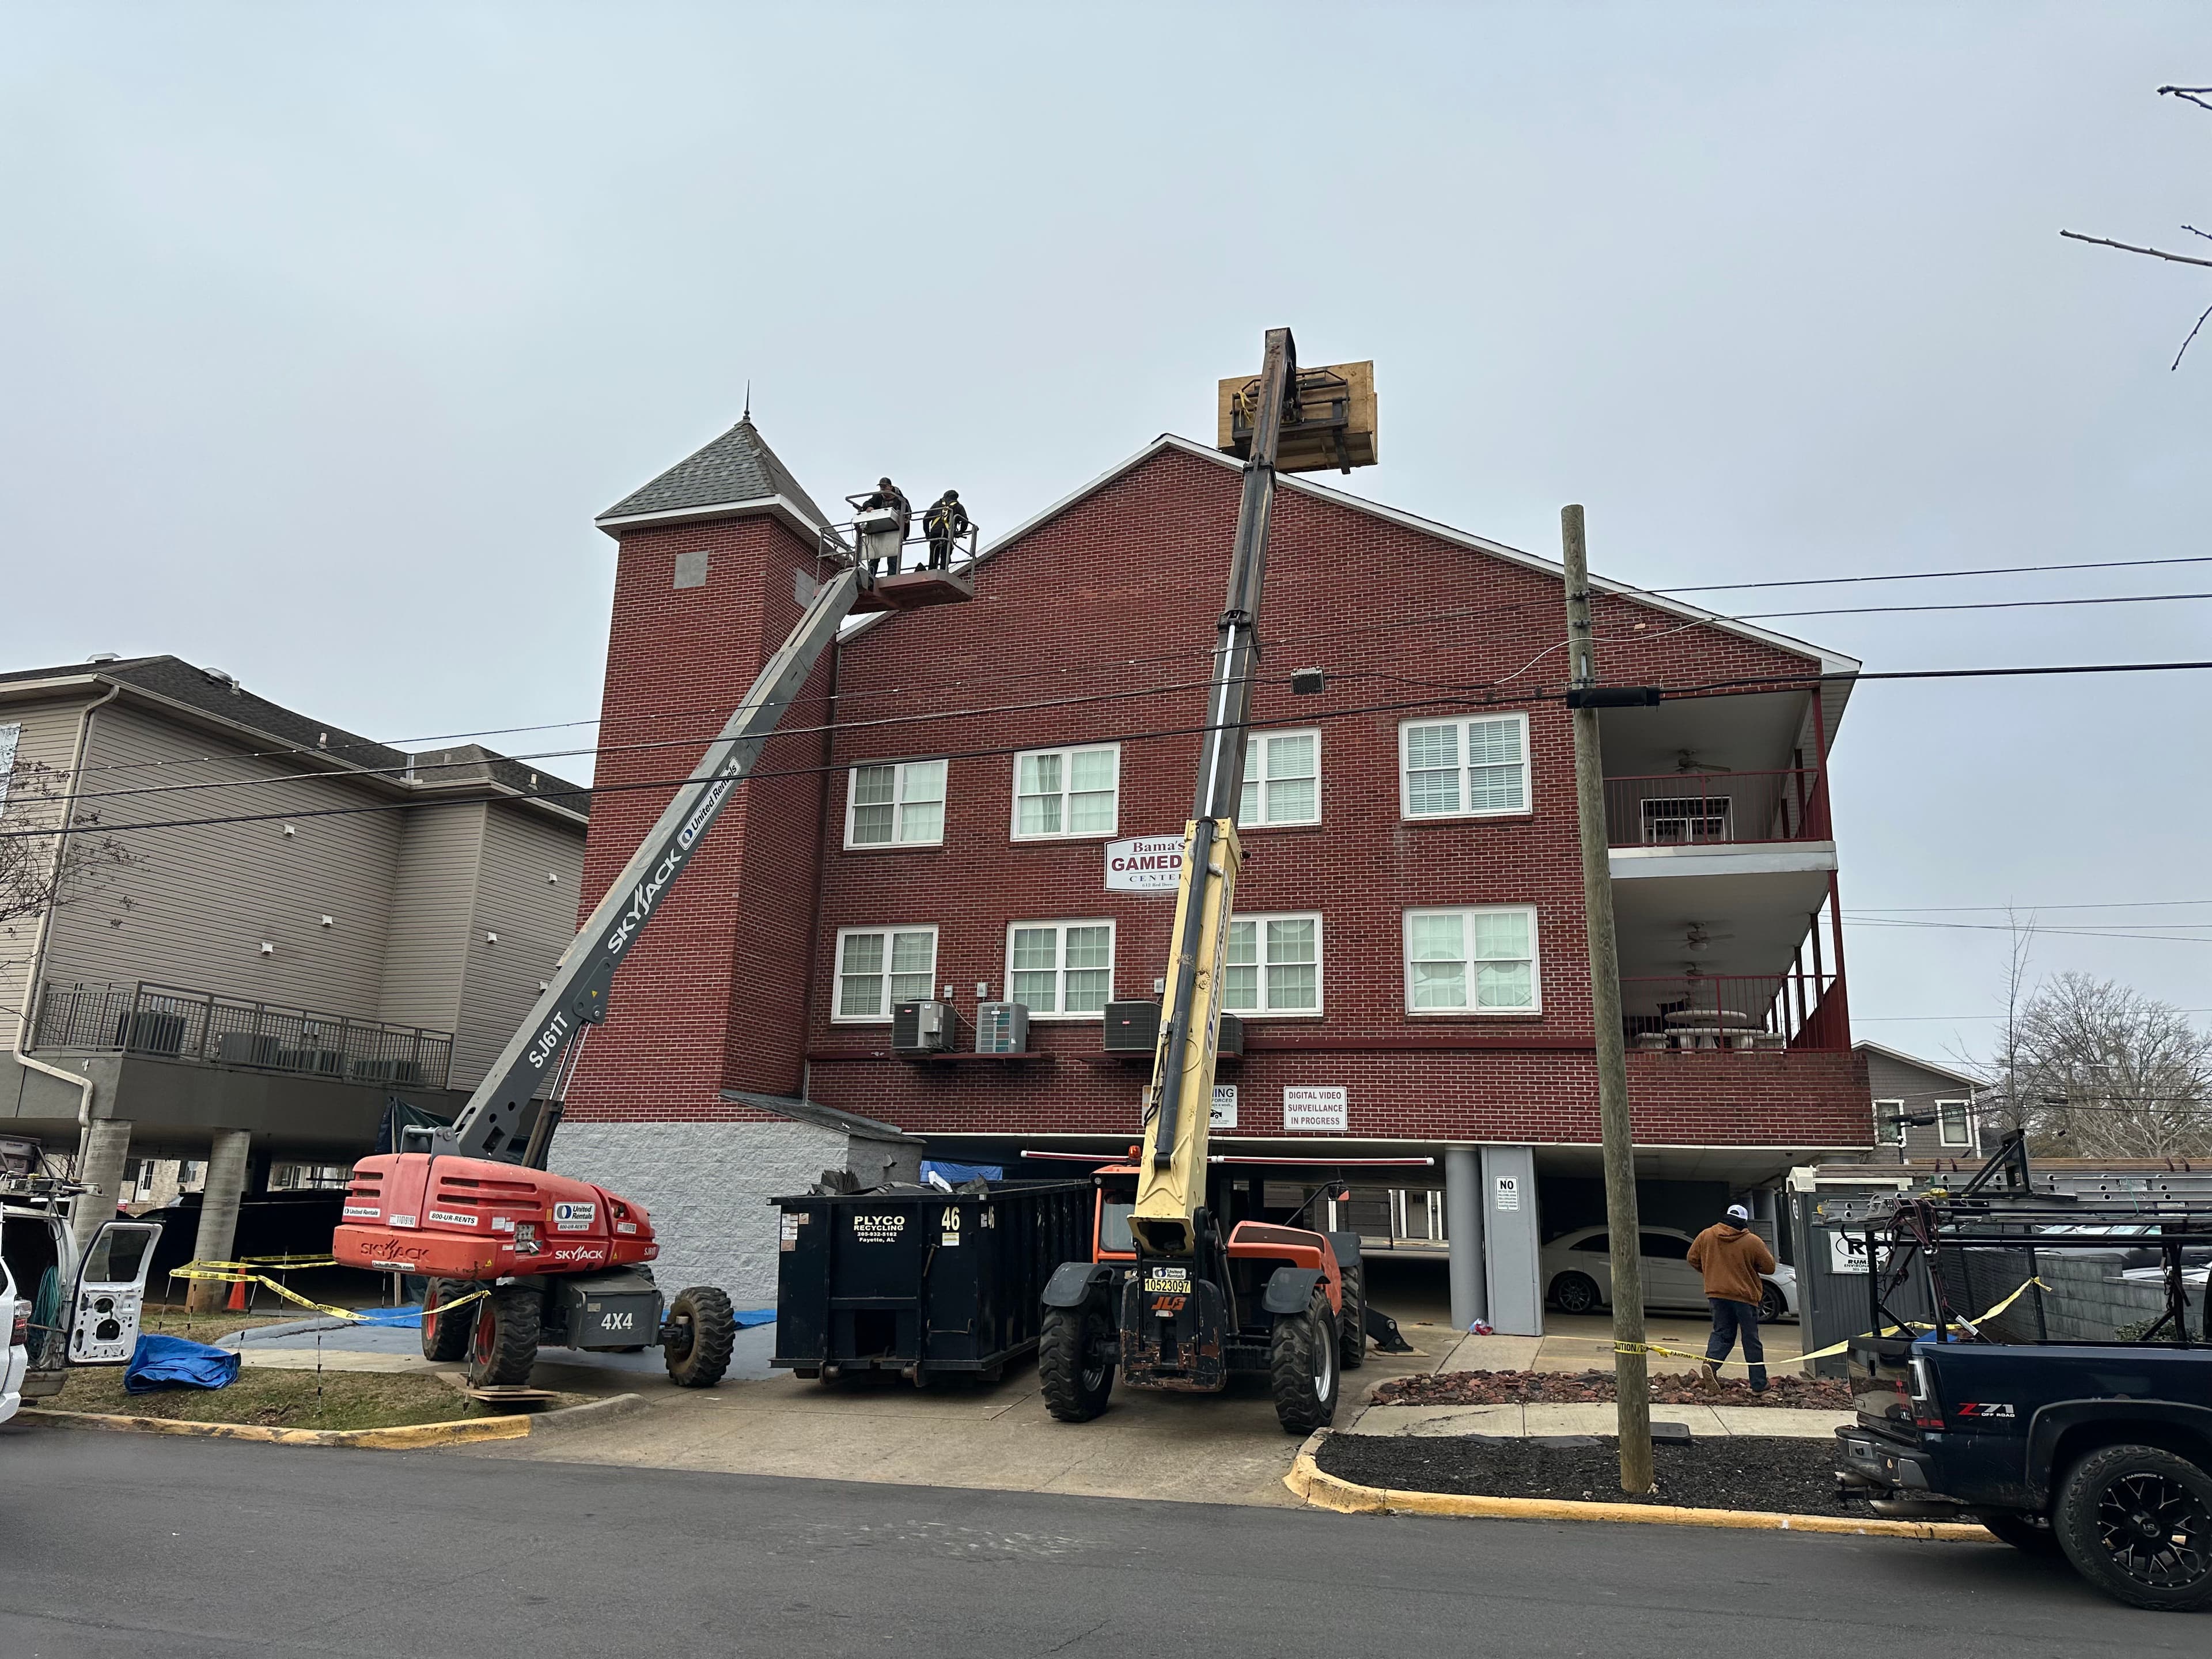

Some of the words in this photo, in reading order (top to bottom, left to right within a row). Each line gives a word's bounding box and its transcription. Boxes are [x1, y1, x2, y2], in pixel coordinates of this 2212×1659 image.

[691, 798, 715, 830] United
[1133, 840, 1185, 852] Bama's
[1111, 855, 1182, 871] GAMED
[608, 848, 682, 954] SKYJACK
[1211, 949, 1221, 1020] United
[529, 1011, 568, 1068] SJ61T
[1301, 1117, 1340, 1125] PROGRESS
[1499, 1180, 1514, 1190] NO
[431, 1213, 475, 1224] 800-UR-RENTS
[854, 1216, 905, 1225] PLYCO
[942, 1207, 960, 1230] 46
[988, 1206, 994, 1229] 46
[361, 1239, 429, 1262] SKYJACK
[555, 1245, 603, 1262] SKYJACK
[1146, 1280, 1189, 1292] 10523097
[1151, 1296, 1187, 1310] JLG
[601, 1313, 632, 1330] 4X4
[1957, 1403, 2014, 1416] Z71
